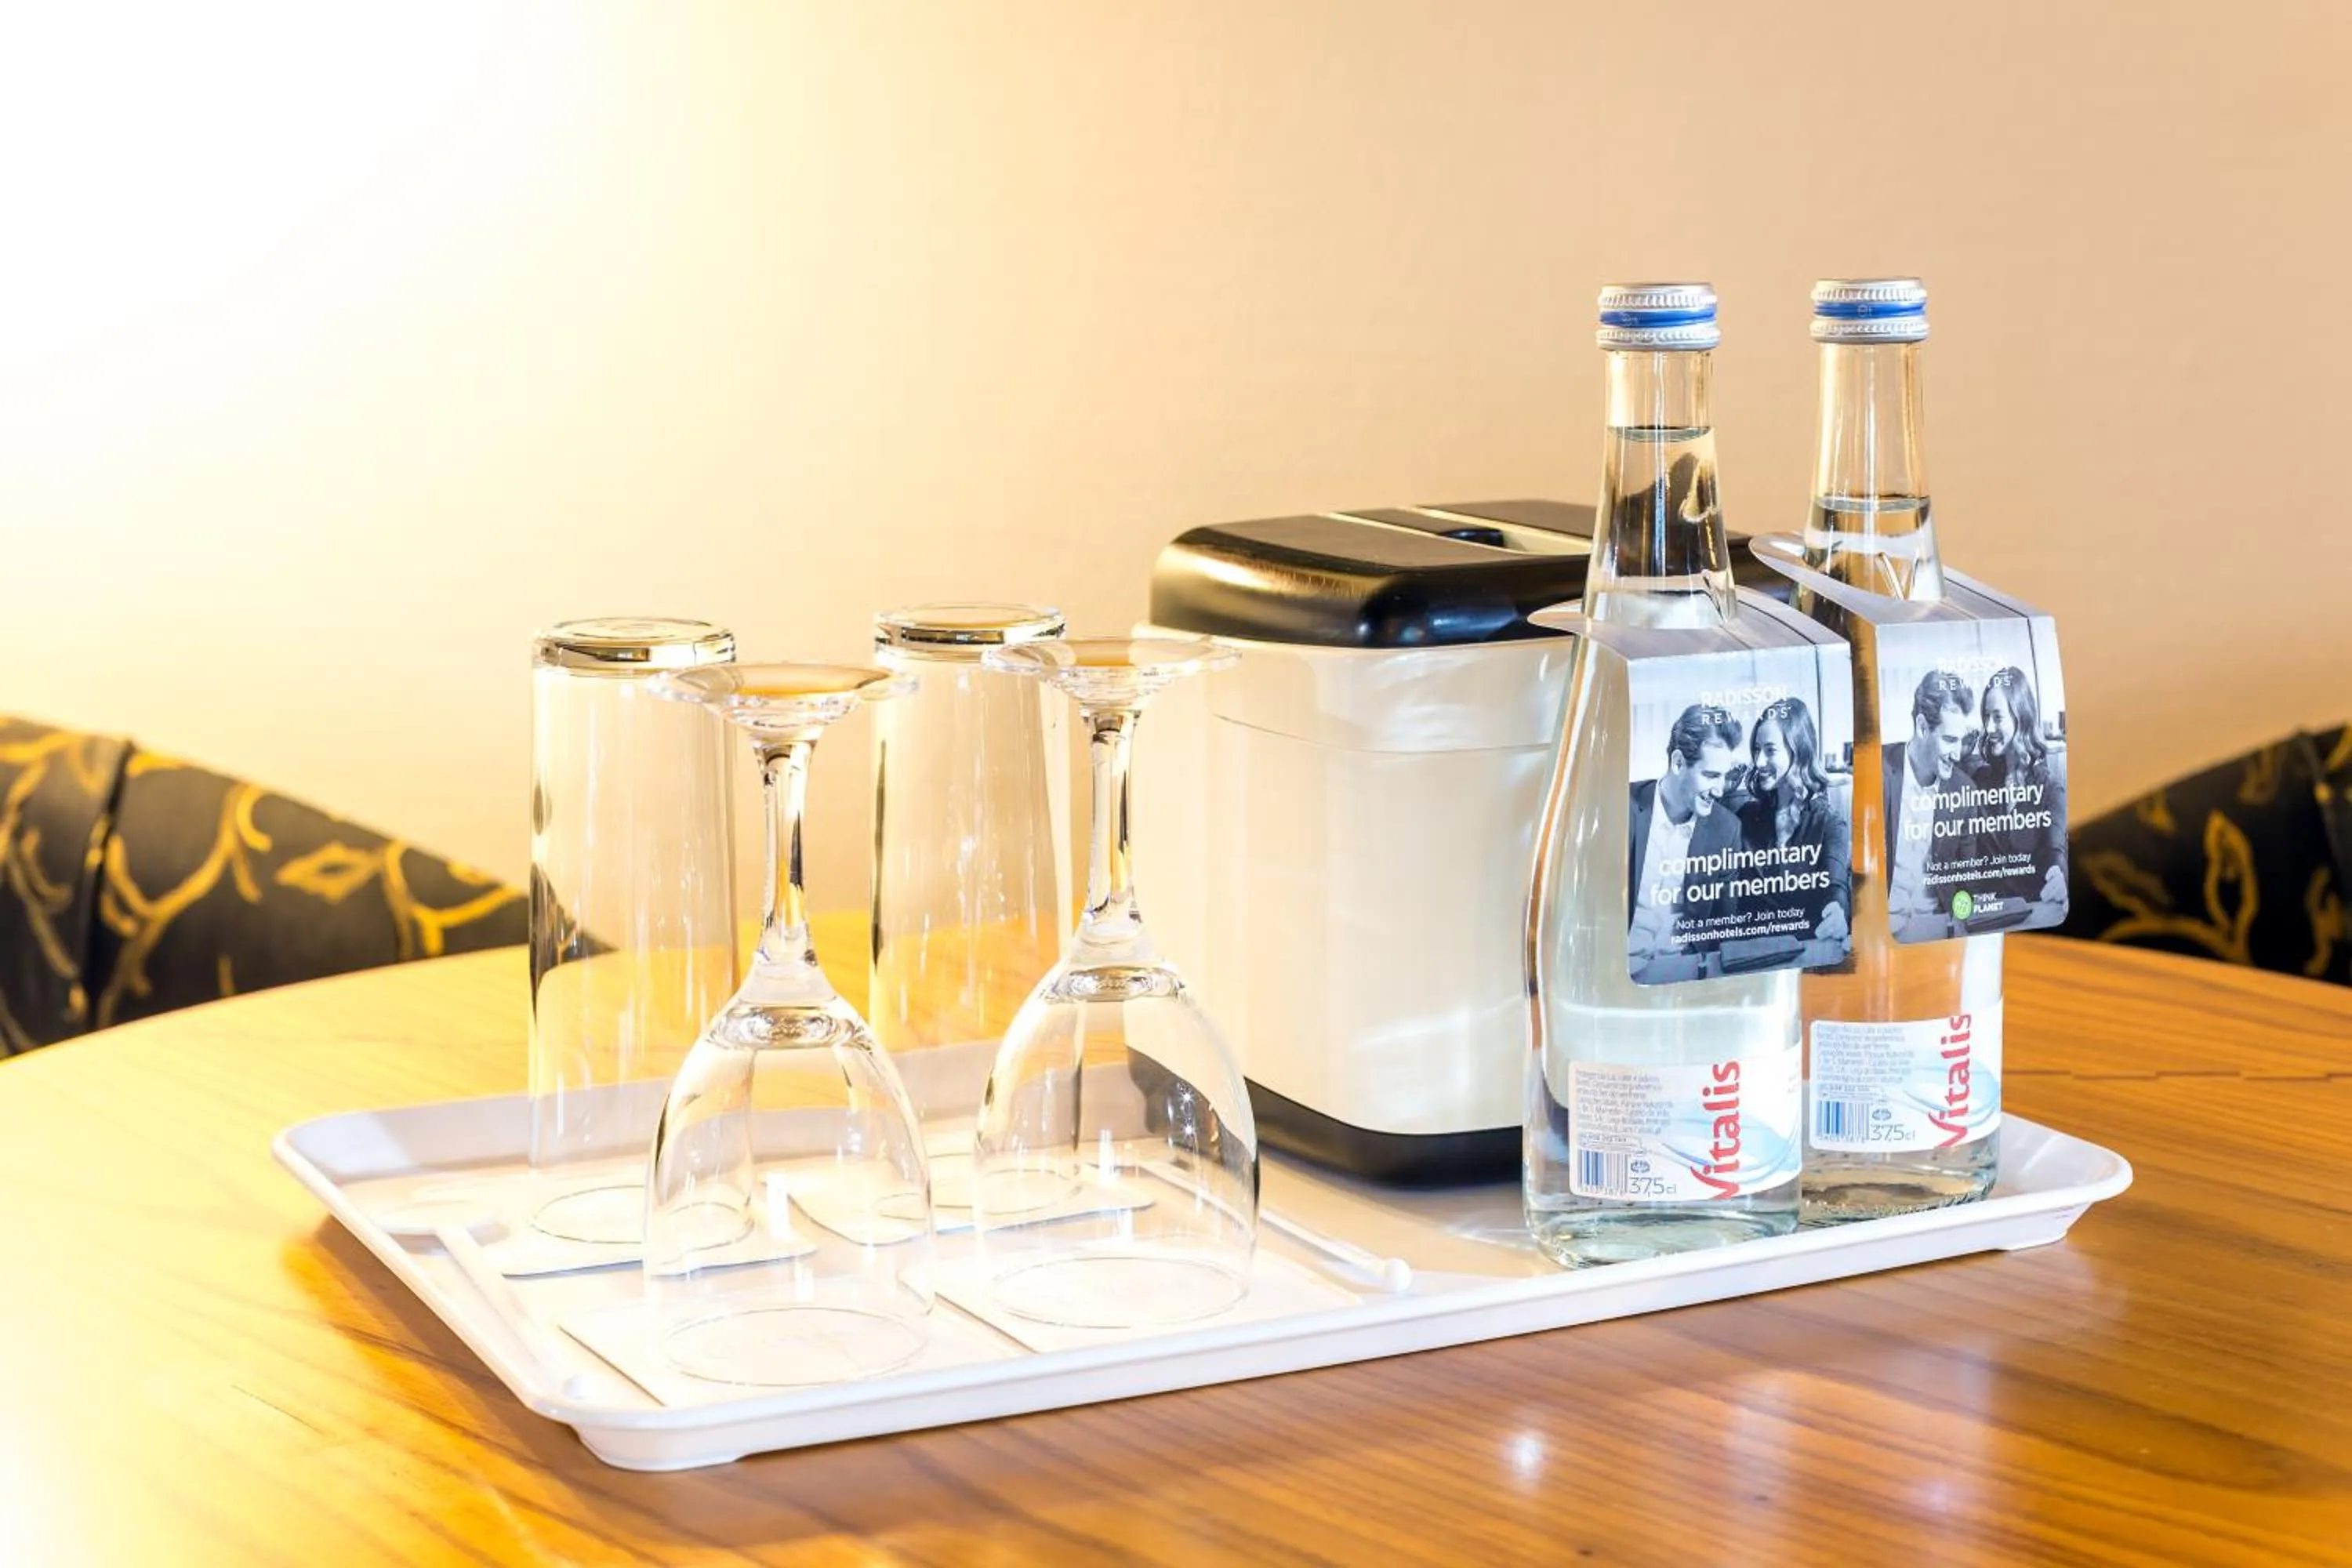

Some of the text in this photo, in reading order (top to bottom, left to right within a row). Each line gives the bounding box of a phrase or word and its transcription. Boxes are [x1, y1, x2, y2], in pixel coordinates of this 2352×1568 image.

[1911, 784, 2044, 813] complimentary
[1904, 809, 2052, 841] for our members
[1659, 843, 1823, 877] complimentary
[1926, 862, 1942, 872] Not
[1950, 855, 1988, 869] member?
[1990, 855, 2006, 865] Join
[2008, 853, 2032, 863] today
[1650, 869, 1831, 906] for our members
[1923, 864, 2036, 886] radissonhotels.com/rewards
[1675, 920, 1695, 931] Not
[1705, 913, 1753, 926] member?
[1754, 909, 1775, 921] Join
[1777, 907, 1806, 919] today
[1973, 902, 2004, 913] PLANET
[1671, 920, 1810, 944] radissonhotels.com/rewards
[1928, 1014, 1972, 1149] Vitalis
[1690, 1060, 1740, 1201] Vitalis
